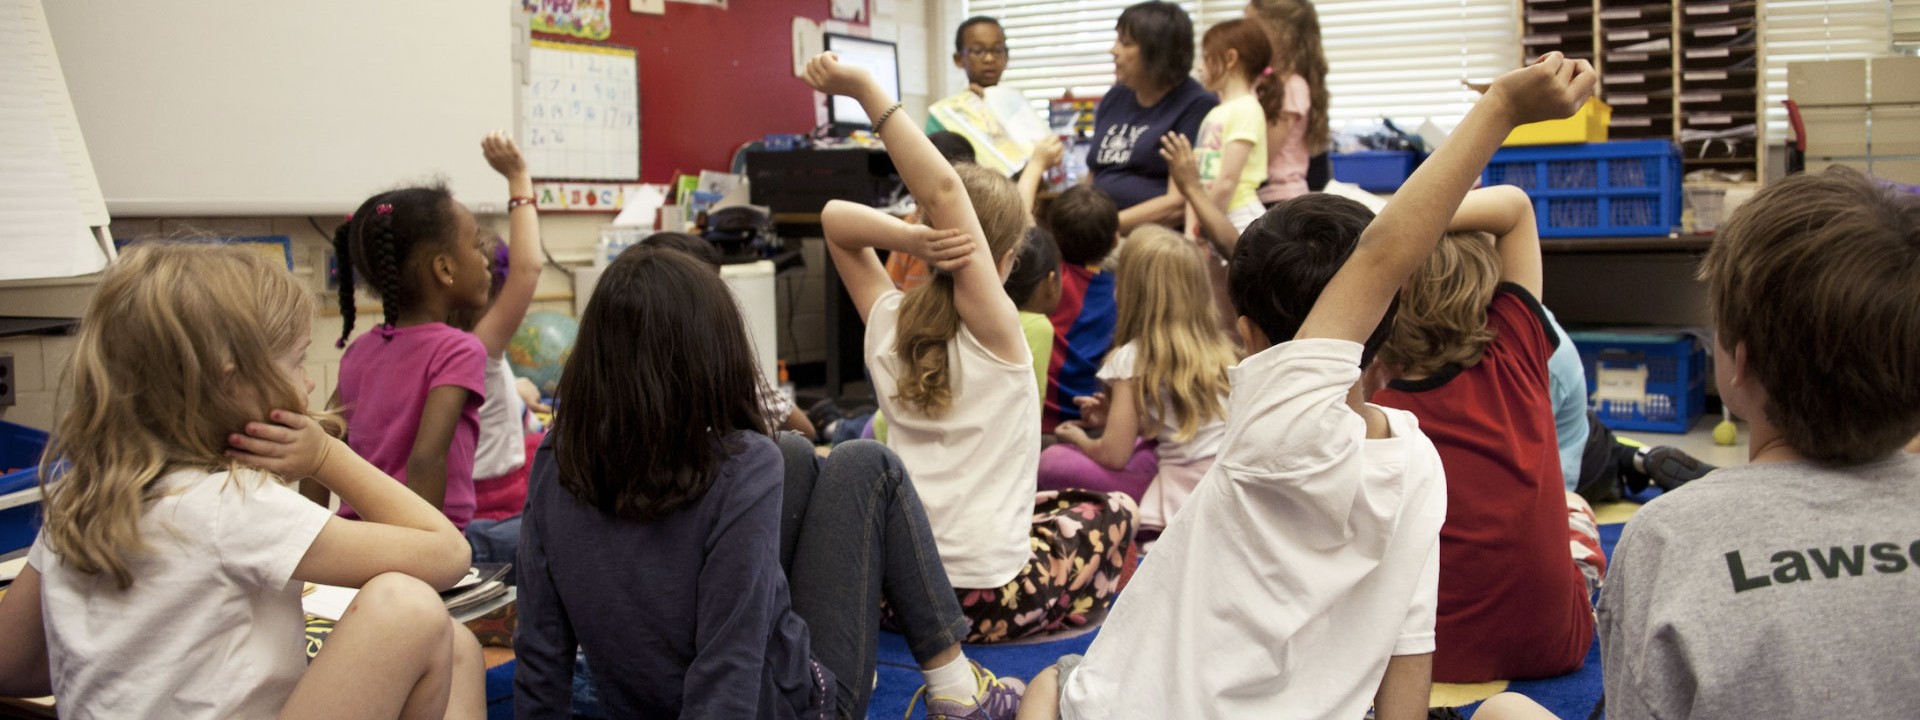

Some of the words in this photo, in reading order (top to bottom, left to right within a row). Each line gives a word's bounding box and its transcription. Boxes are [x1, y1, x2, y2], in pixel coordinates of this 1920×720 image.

[602, 106, 619, 128] 17
[541, 189, 553, 204] A
[601, 190, 612, 205] C
